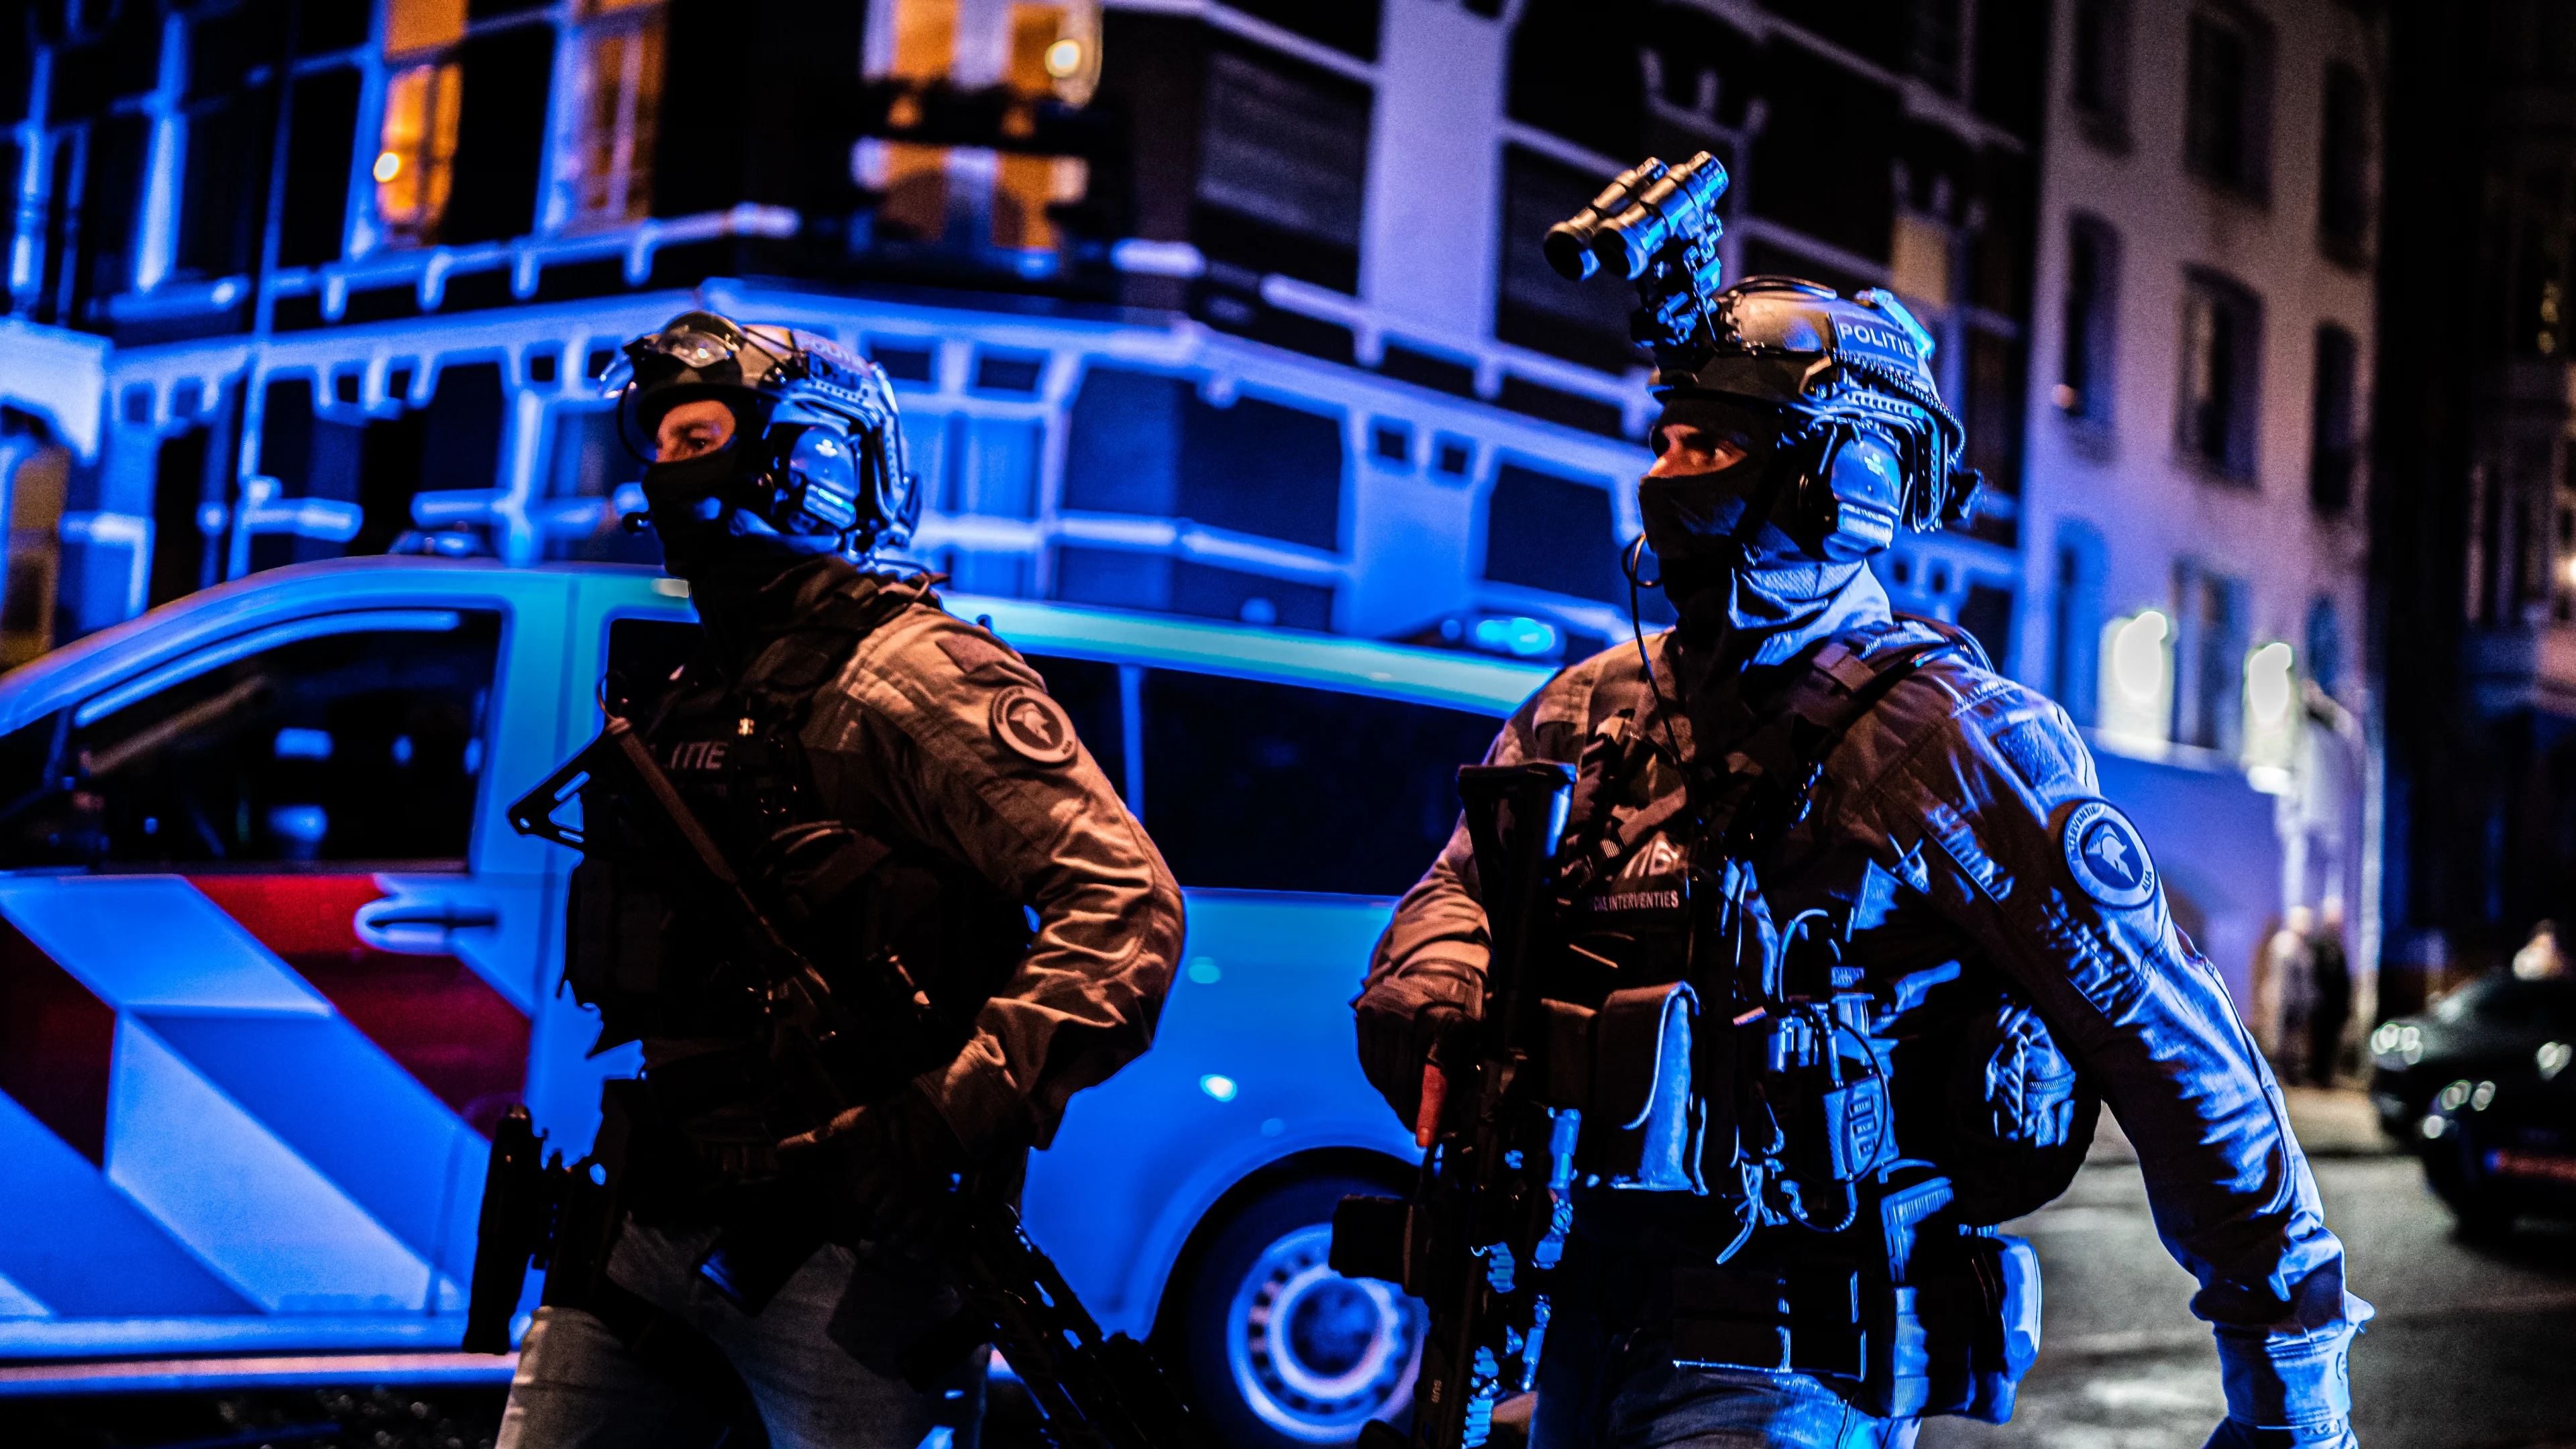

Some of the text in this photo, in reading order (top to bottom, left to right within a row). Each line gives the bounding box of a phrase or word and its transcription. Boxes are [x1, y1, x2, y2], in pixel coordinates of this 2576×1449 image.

[1839, 323, 1915, 360] POLITIE
[661, 740, 729, 770] ITIE
[1609, 889, 1679, 912] INTERVENTIES
